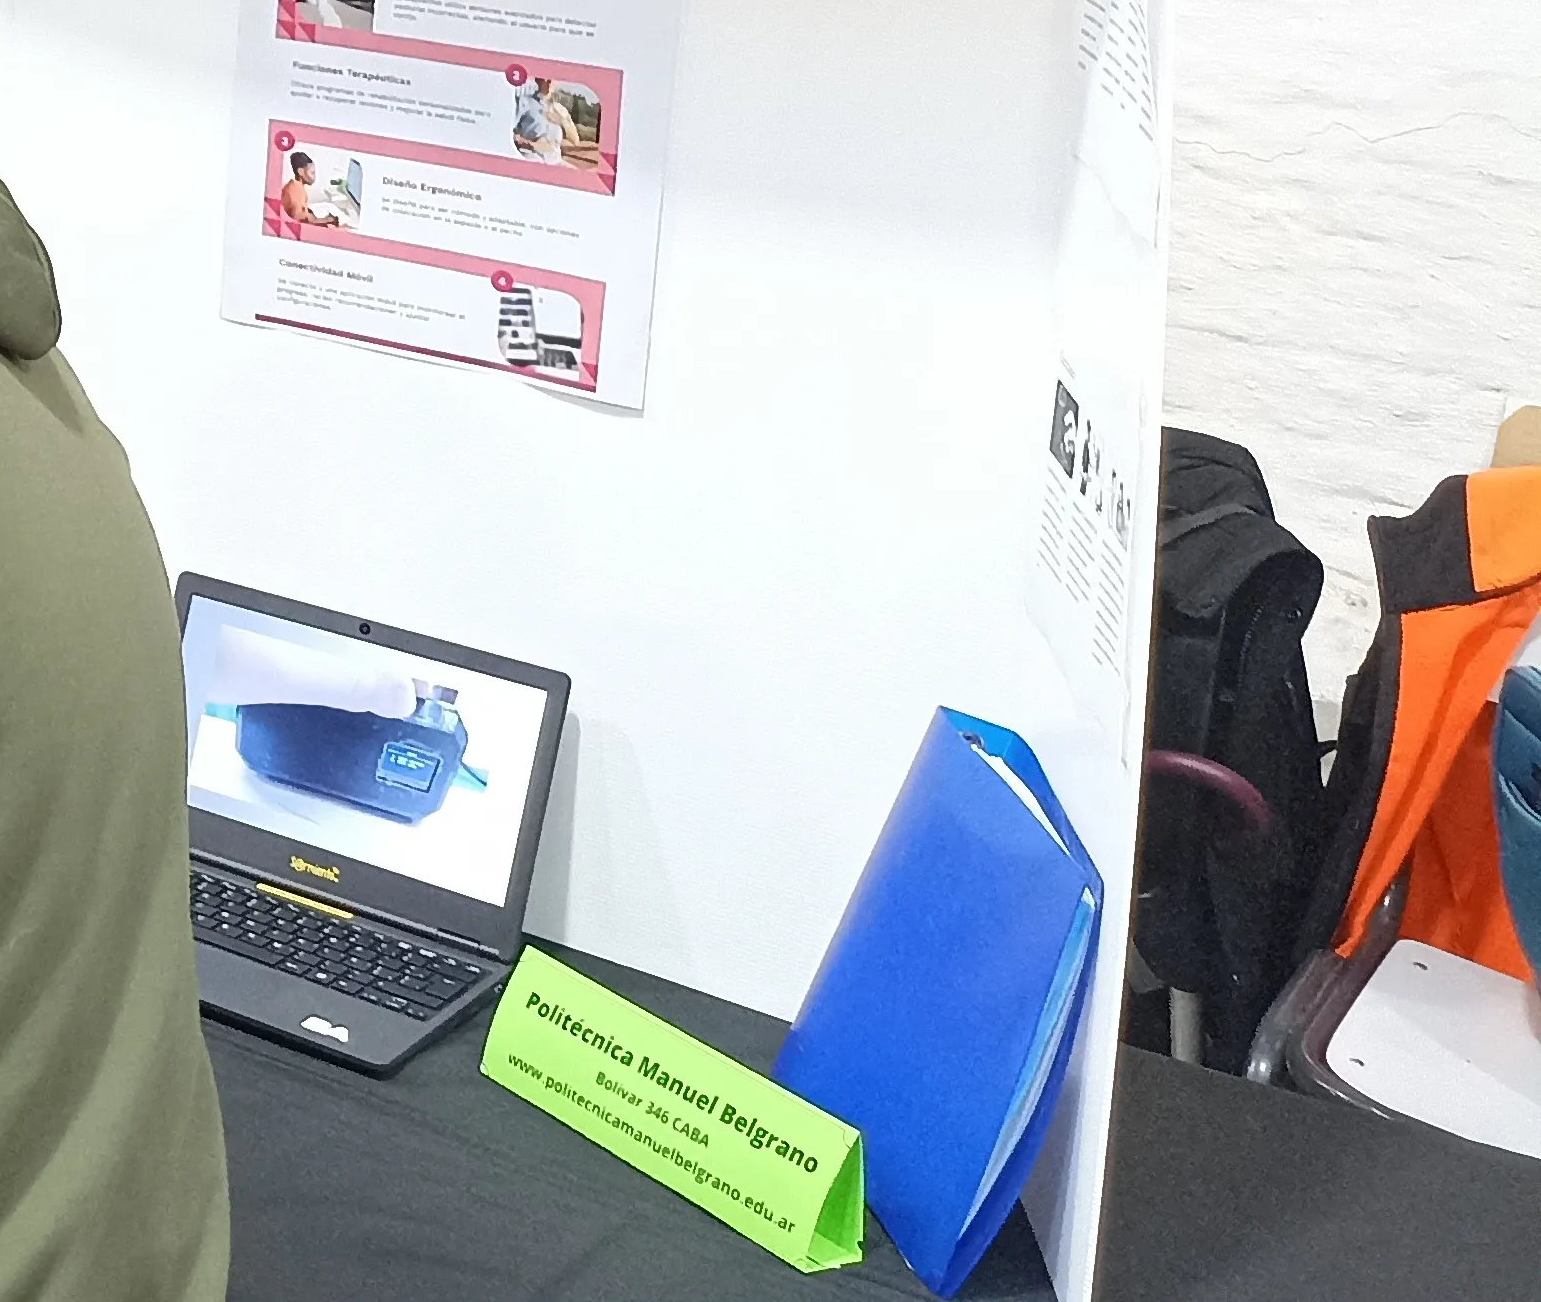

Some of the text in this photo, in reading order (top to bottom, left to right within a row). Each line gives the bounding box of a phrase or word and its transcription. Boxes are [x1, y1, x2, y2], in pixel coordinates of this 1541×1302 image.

[508, 1052, 796, 1234] www.politecnicamanuelbelgrano.edu.ar
[525, 991, 819, 1174] Politécnica Manuel Belgrano
[645, 1100, 670, 1125] 346
[672, 1117, 711, 1149] CABA
